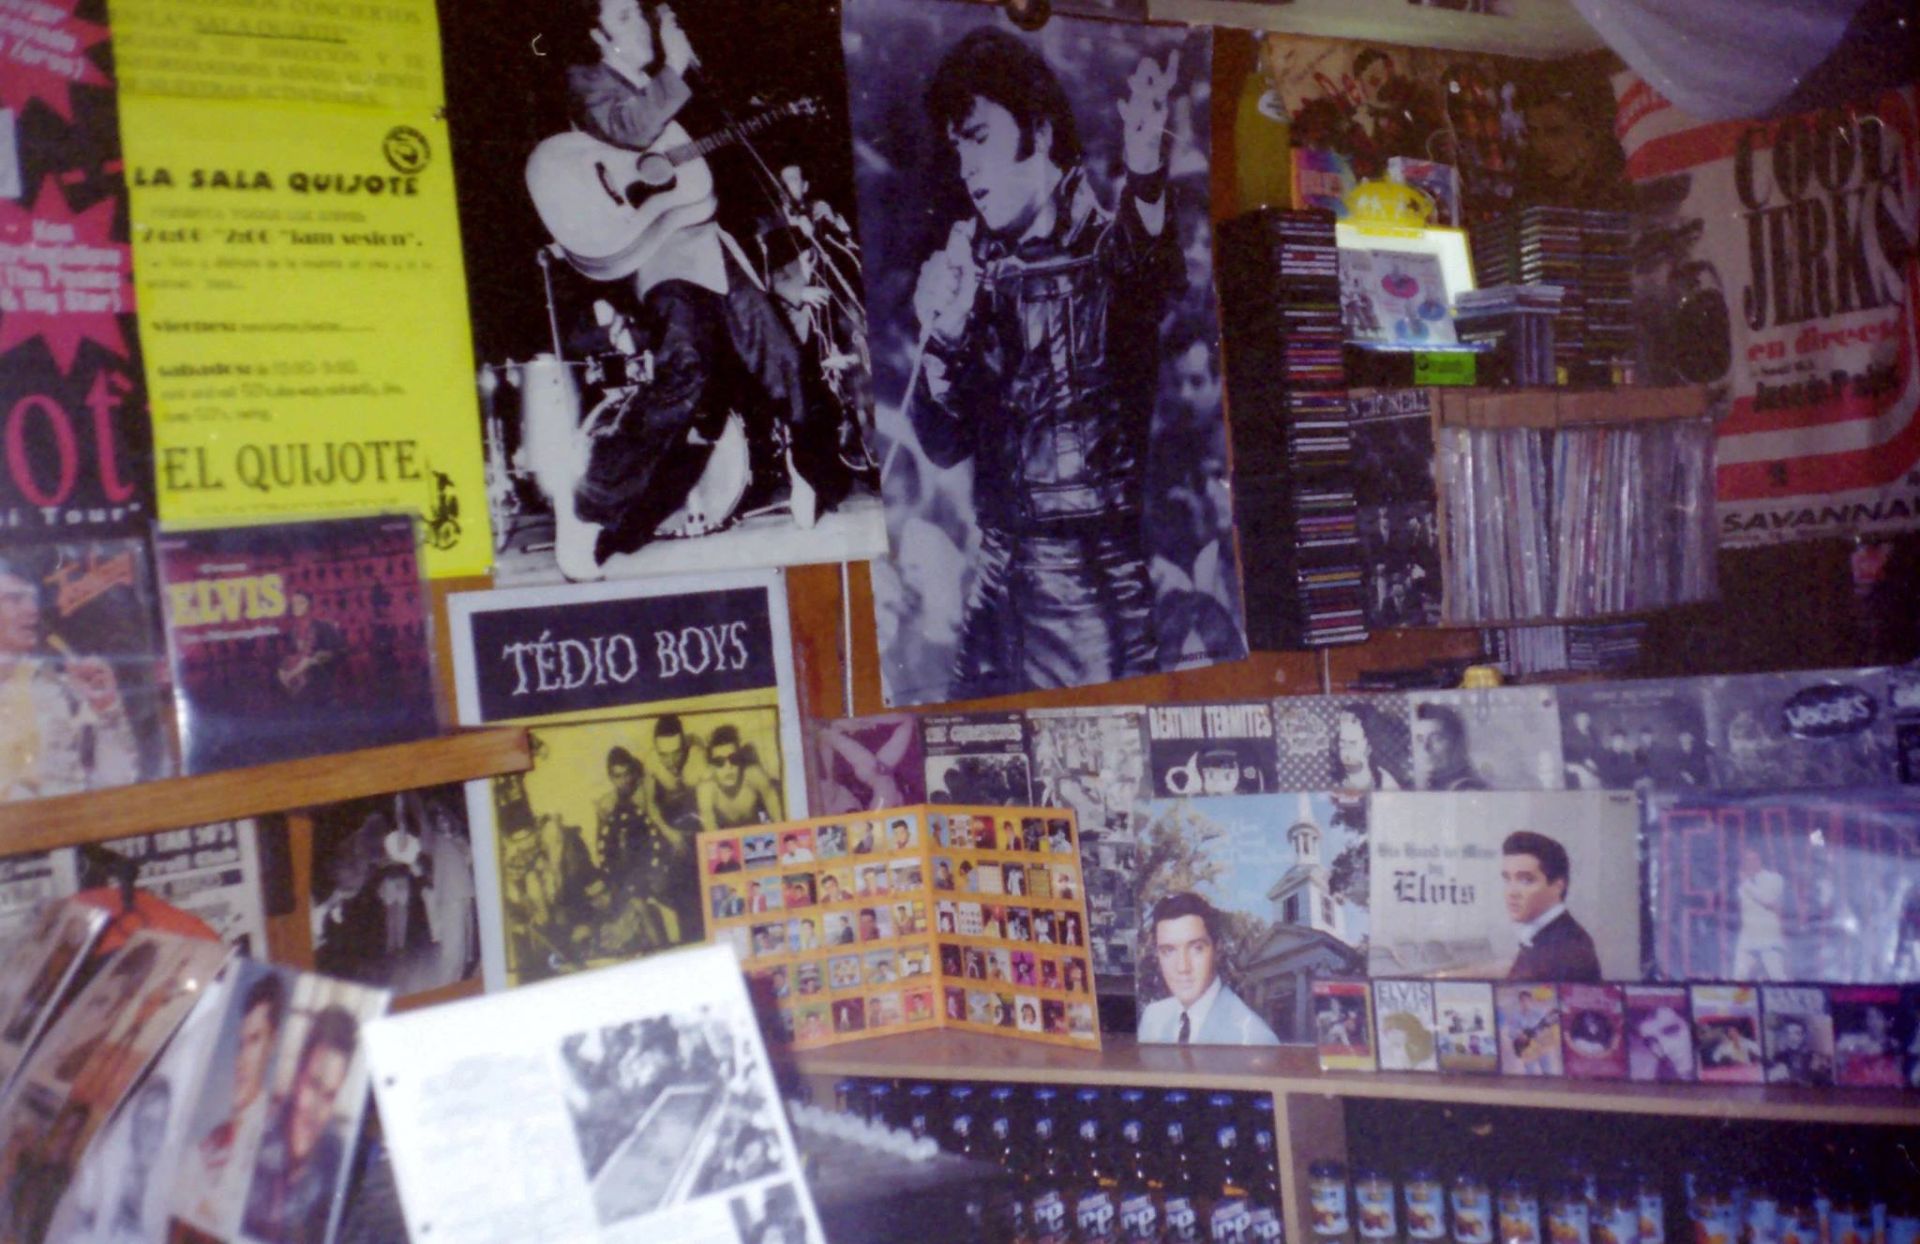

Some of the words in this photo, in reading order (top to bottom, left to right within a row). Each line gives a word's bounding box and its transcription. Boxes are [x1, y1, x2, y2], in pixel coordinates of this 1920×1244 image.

[134, 167, 174, 187] LA
[190, 170, 274, 191] SALA
[289, 173, 420, 196] QUIJOTE
[163, 445, 224, 491] EL
[234, 438, 420, 493] QUIJOTE
[168, 574, 287, 628] ELVIS
[502, 629, 638, 696] TÉDIO
[653, 620, 748, 678] BOYS
[1393, 870, 1475, 905] Elvis
[1377, 983, 1430, 1000] ELVIS
